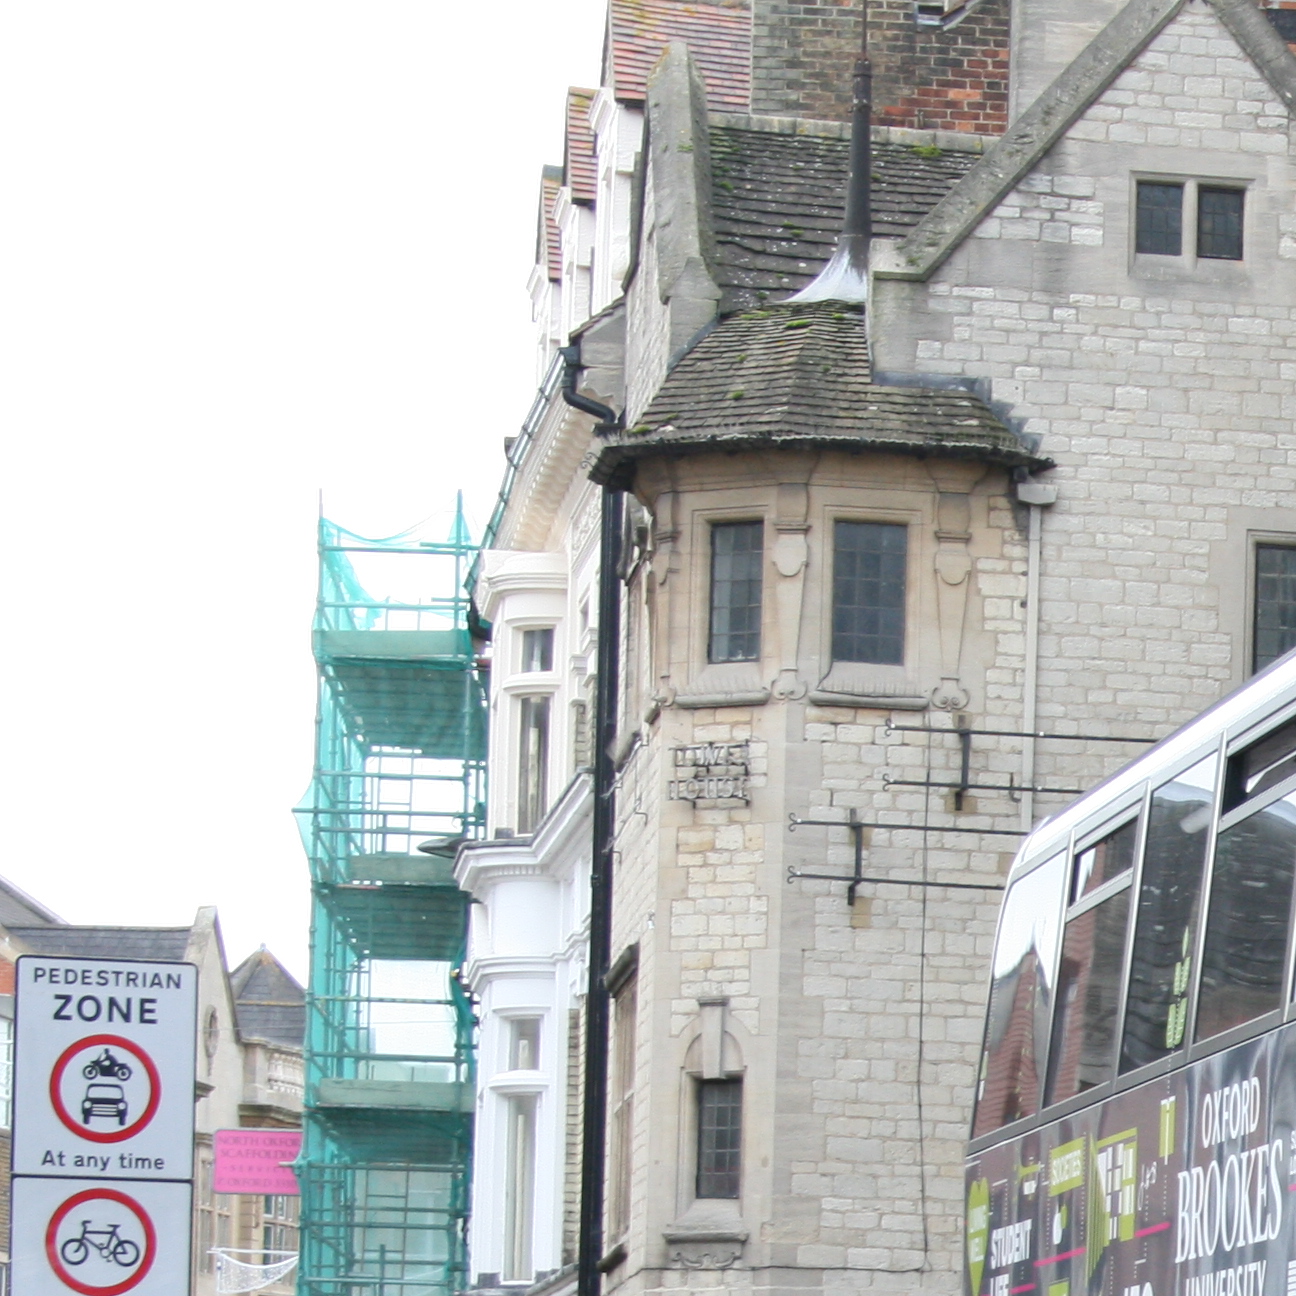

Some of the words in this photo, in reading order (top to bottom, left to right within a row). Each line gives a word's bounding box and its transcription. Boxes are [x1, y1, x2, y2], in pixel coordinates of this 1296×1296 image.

[34, 967, 181, 989] PEDESTRIAN
[53, 994, 158, 1024] ZONE
[1201, 1076, 1261, 1148] OXFORD
[41, 1150, 66, 1167] At
[73, 1155, 110, 1171] any
[119, 1153, 165, 1170] time
[1175, 1139, 1283, 1263] BROOKES
[990, 1219, 1032, 1269] STUDENT
